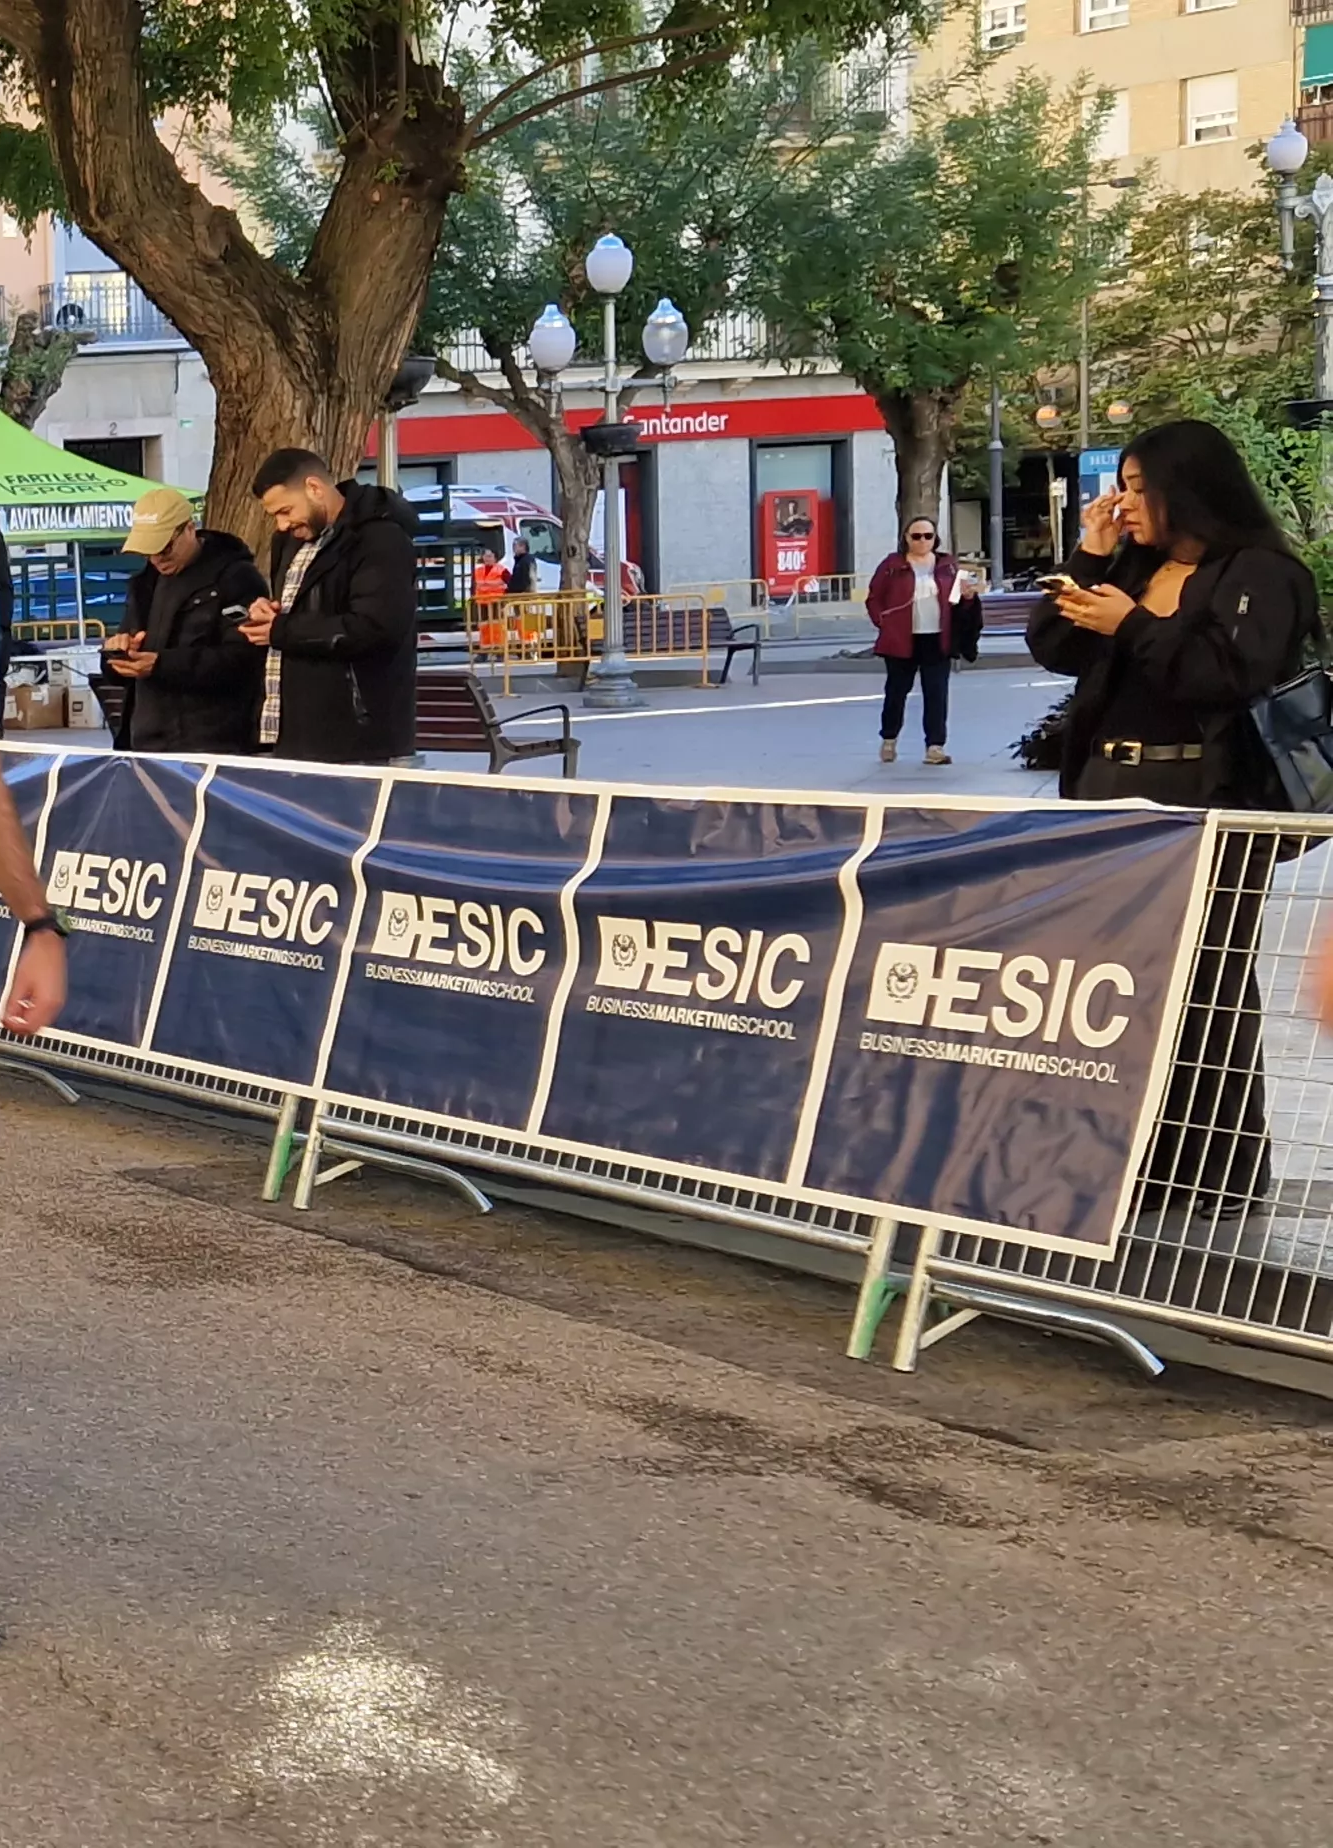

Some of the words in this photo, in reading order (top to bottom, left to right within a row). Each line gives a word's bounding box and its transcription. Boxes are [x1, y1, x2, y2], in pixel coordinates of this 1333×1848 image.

[109, 422, 118, 436] 2
[5, 472, 103, 484] FARTLECK
[19, 485, 110, 496] SPORT
[10, 504, 134, 530] AVITUALLAMIENTO
[74, 854, 167, 920] ESIC
[228, 873, 339, 945] ESIC
[416, 896, 546, 976] ESIC
[646, 921, 811, 1009] ESIC
[930, 948, 1135, 1048] ESIC
